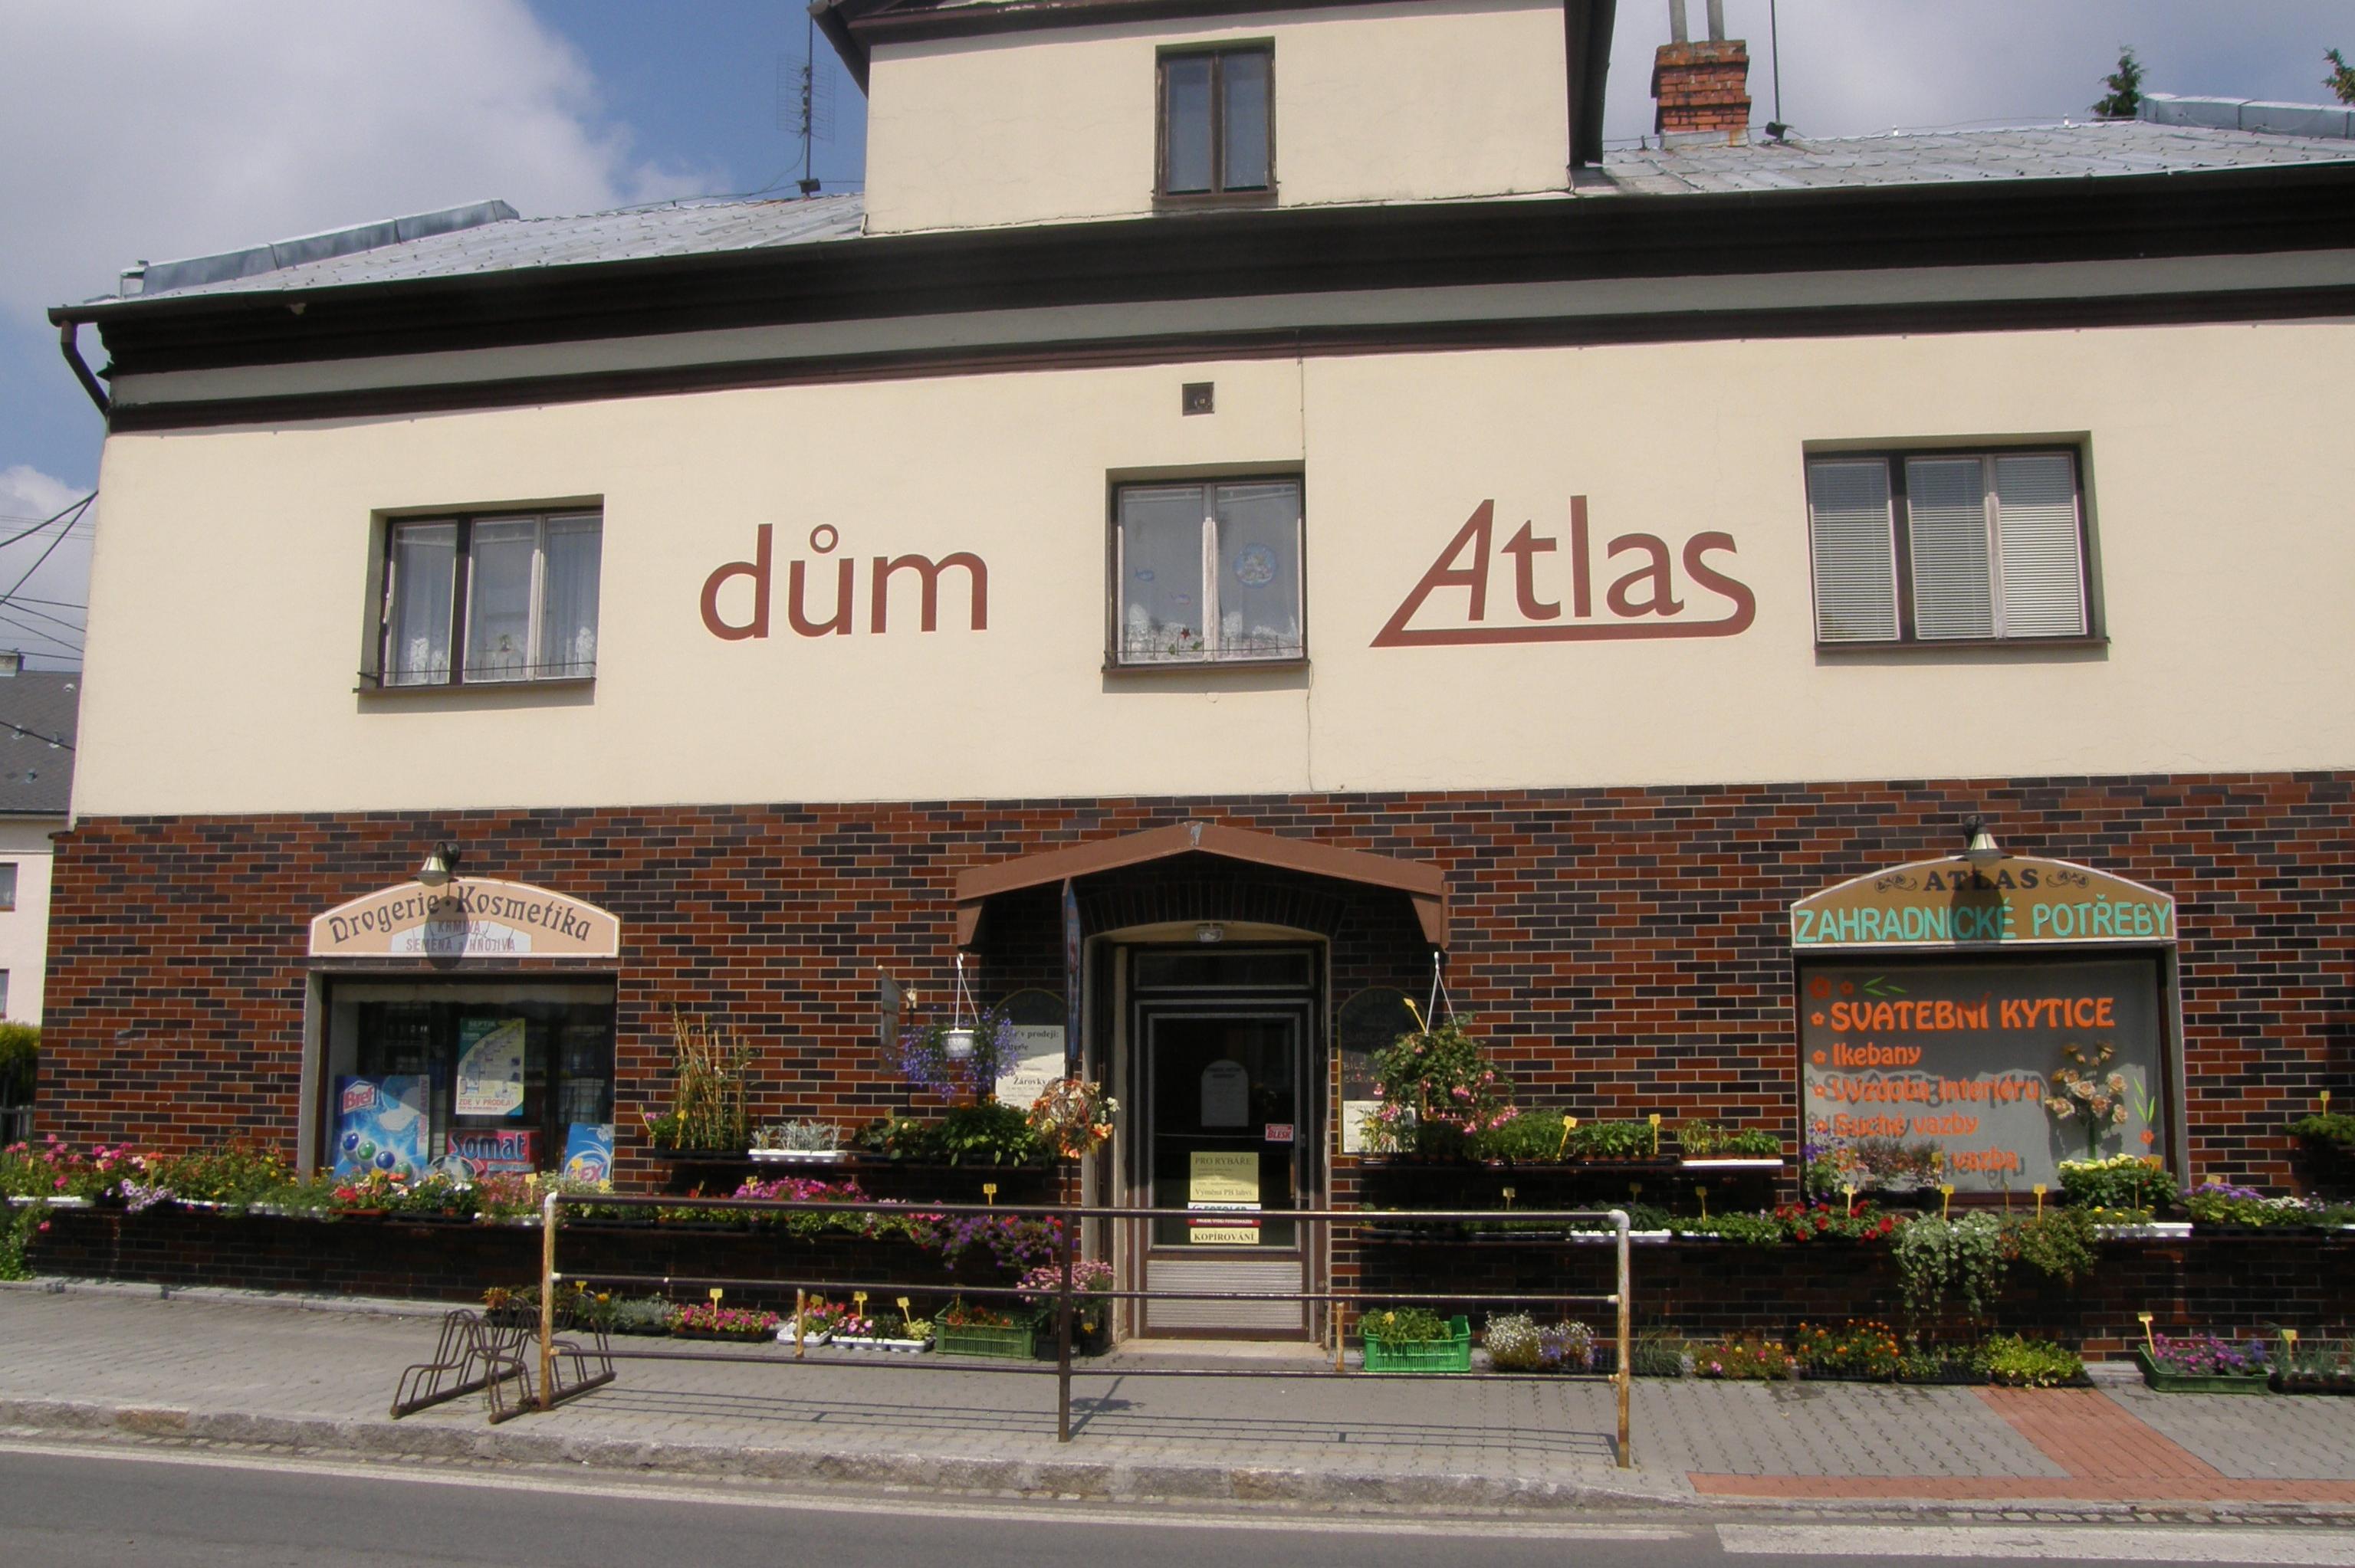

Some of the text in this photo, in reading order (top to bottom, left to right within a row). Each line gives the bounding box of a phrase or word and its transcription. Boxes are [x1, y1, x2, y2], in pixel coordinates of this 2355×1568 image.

[700, 523, 988, 641] dům
[1369, 494, 1756, 648] Atlas
[1923, 868, 2039, 891] ATLAS
[329, 886, 591, 943] Drogerie Kosmetika
[438, 920, 481, 933] KRMIVA
[1795, 894, 2172, 943] ZAHRADNICKÉ POTŘEBY
[406, 938, 453, 952] SEMENA
[469, 937, 516, 952] HNOJIVA
[1830, 992, 2116, 1031] SVATEBNÍ KYTICE
[1833, 1042, 1921, 1067] Ikebany
[343, 1085, 374, 1110] Bref
[1831, 1074, 2040, 1104] Výzdoba interiéru
[1267, 1130, 1292, 1140] BLESK
[1833, 1110, 1979, 1137] Suché vazby
[450, 1131, 526, 1161] Somat
[1951, 1145, 2018, 1170] vazba
[1194, 1232, 1254, 1241] KOPÍROVÁNÍ
